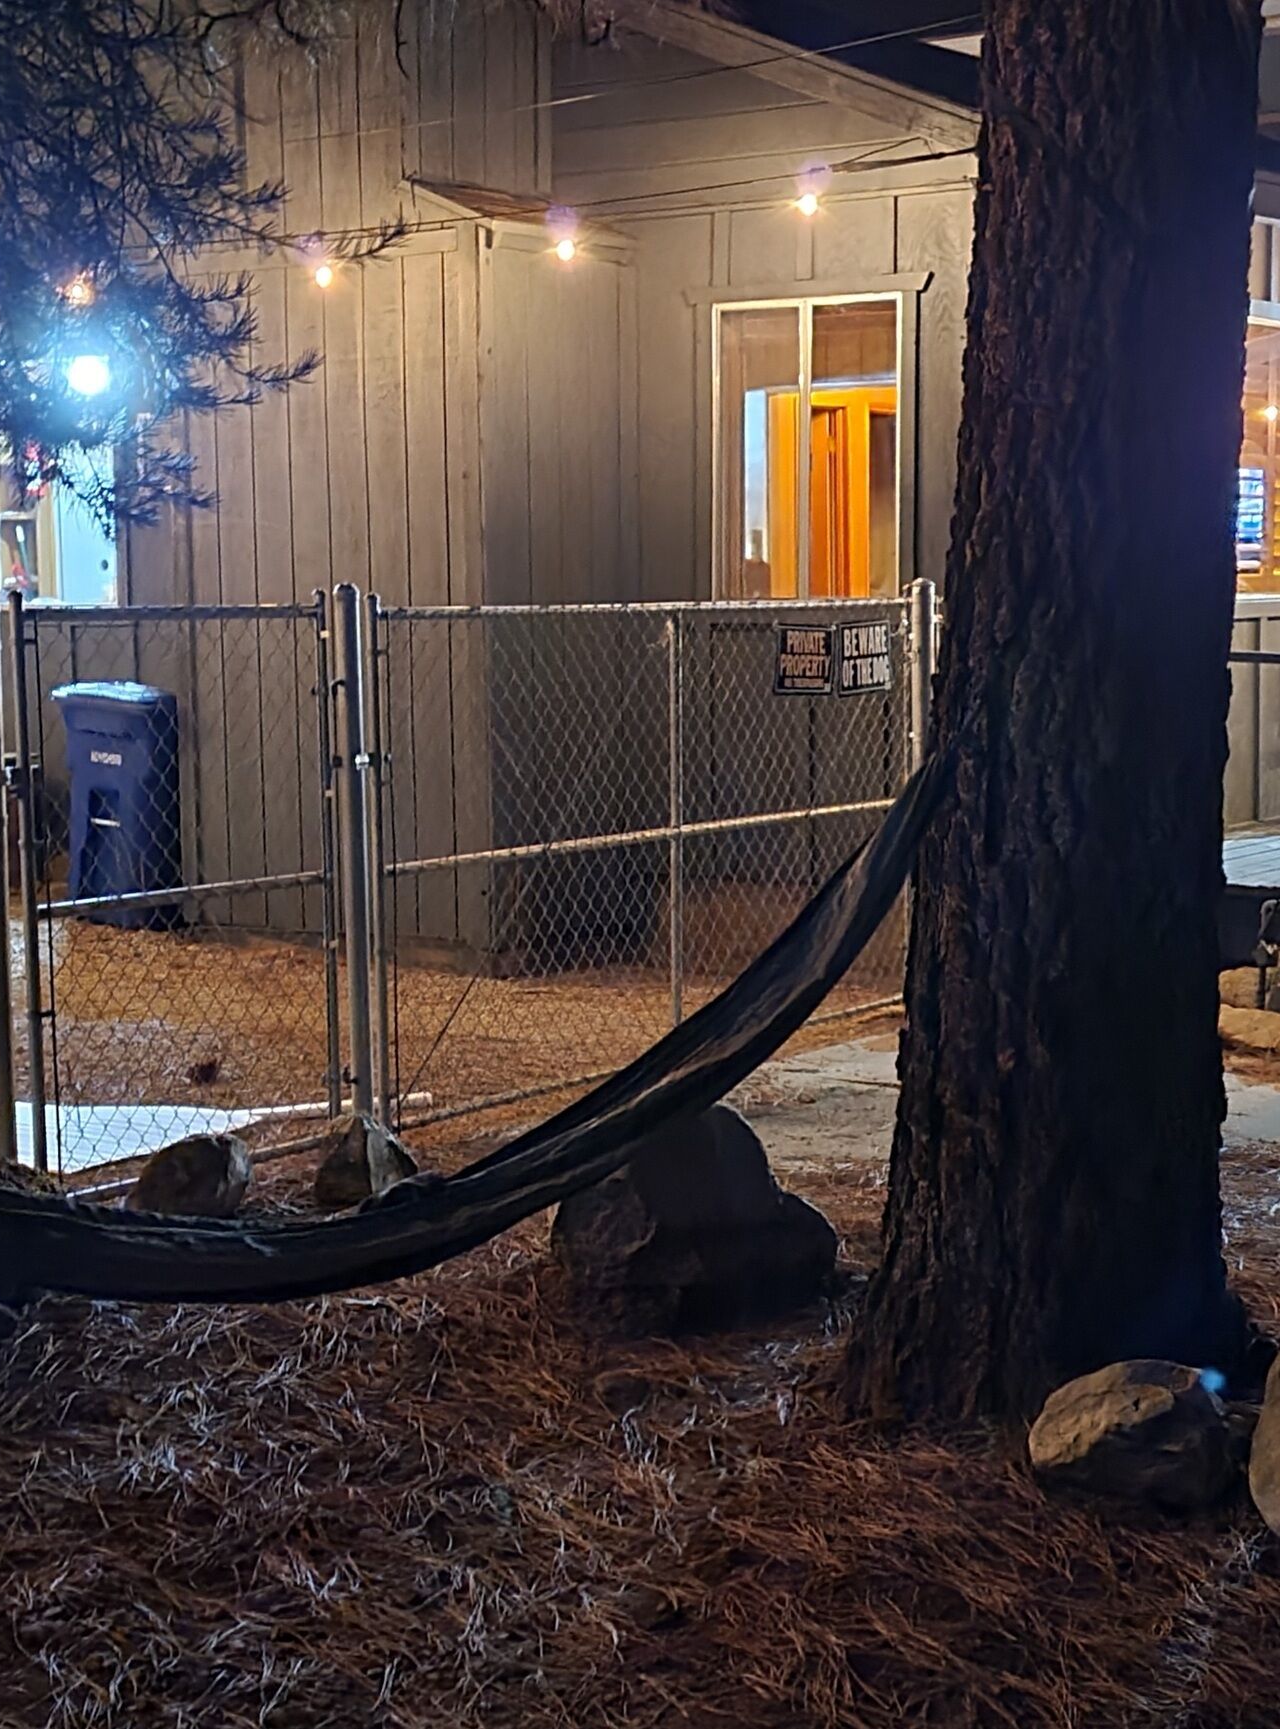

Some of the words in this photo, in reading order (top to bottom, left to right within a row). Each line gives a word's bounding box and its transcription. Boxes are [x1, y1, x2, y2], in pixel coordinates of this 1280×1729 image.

[787, 631, 826, 653] PRIVATE
[843, 625, 888, 657] BEWARE
[780, 654, 831, 677] PROPERTY
[843, 660, 854, 687] OF
[855, 657, 872, 686] THE
